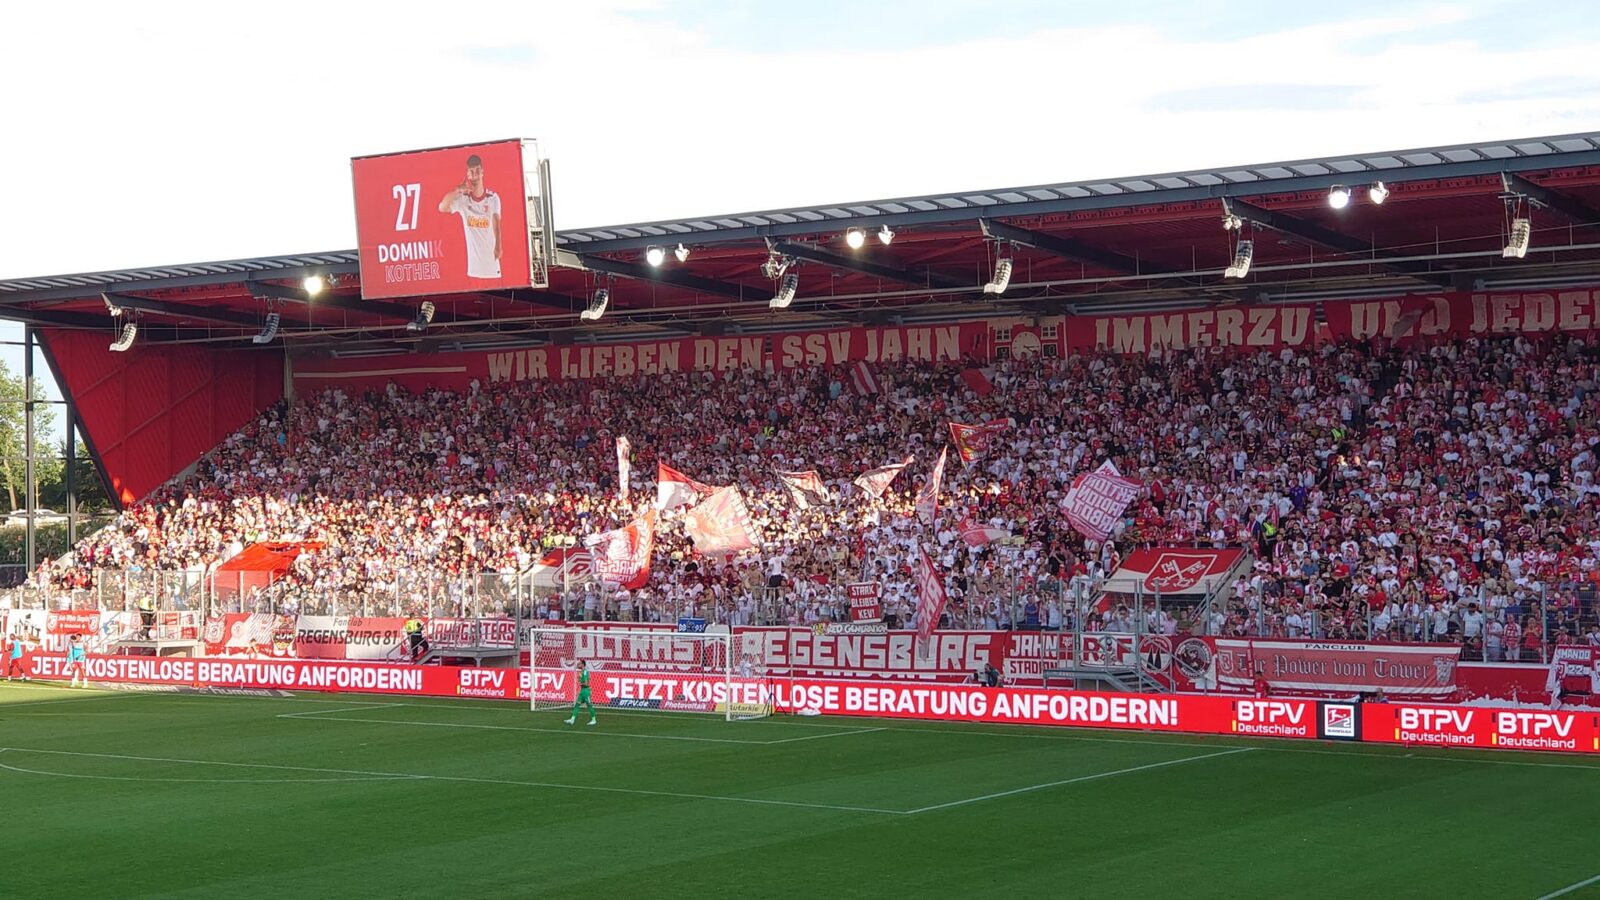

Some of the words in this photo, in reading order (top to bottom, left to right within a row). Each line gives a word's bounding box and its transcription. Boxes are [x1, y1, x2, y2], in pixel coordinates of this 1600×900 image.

[393, 183, 421, 231] 27
[378, 241, 444, 263] DOMINIK
[384, 262, 440, 283] KOTHER
[1095, 307, 1311, 354] IMMERZU
[487, 349, 548, 382] WIR
[561, 342, 680, 379] LIEBEN
[694, 337, 764, 371] DEN
[782, 331, 851, 369] SSV
[865, 326, 961, 364] JAHN
[333, 617, 363, 627] Fanclub
[858, 608, 875, 620] KEV!
[298, 629, 381, 646] REGENSBURG
[383, 631, 398, 646] 81
[574, 626, 694, 663] ULTRAS
[1010, 634, 1058, 658] JAHN
[1304, 643, 1366, 652] FANCLUB
[741, 630, 993, 672] REGENSBURG
[31, 656, 77, 677] JETZ
[85, 659, 195, 681] KOSTENLOSE
[198, 662, 296, 686] BERATUNG
[298, 666, 423, 690] ANFORDERN!
[461, 669, 504, 688] BTPV
[1274, 654, 1327, 677] Power
[1333, 658, 1367, 678] vom
[1373, 658, 1430, 681] Tower
[520, 671, 565, 691] BTPV
[461, 687, 505, 698] Deutschland
[520, 690, 566, 701] Detschland
[605, 677, 677, 702] JETZT
[682, 680, 839, 710] KOSTENLOSE
[845, 687, 987, 717] BERATUNG
[992, 692, 1178, 726] ANFORDERN!
[1237, 701, 1305, 724] BTPV
[1401, 708, 1474, 733] BTPV
[1237, 723, 1306, 737] Deutschland
[1498, 713, 1575, 738] BTPV
[1401, 731, 1475, 745] Deutschland
[1498, 735, 1576, 750] Deutschland
